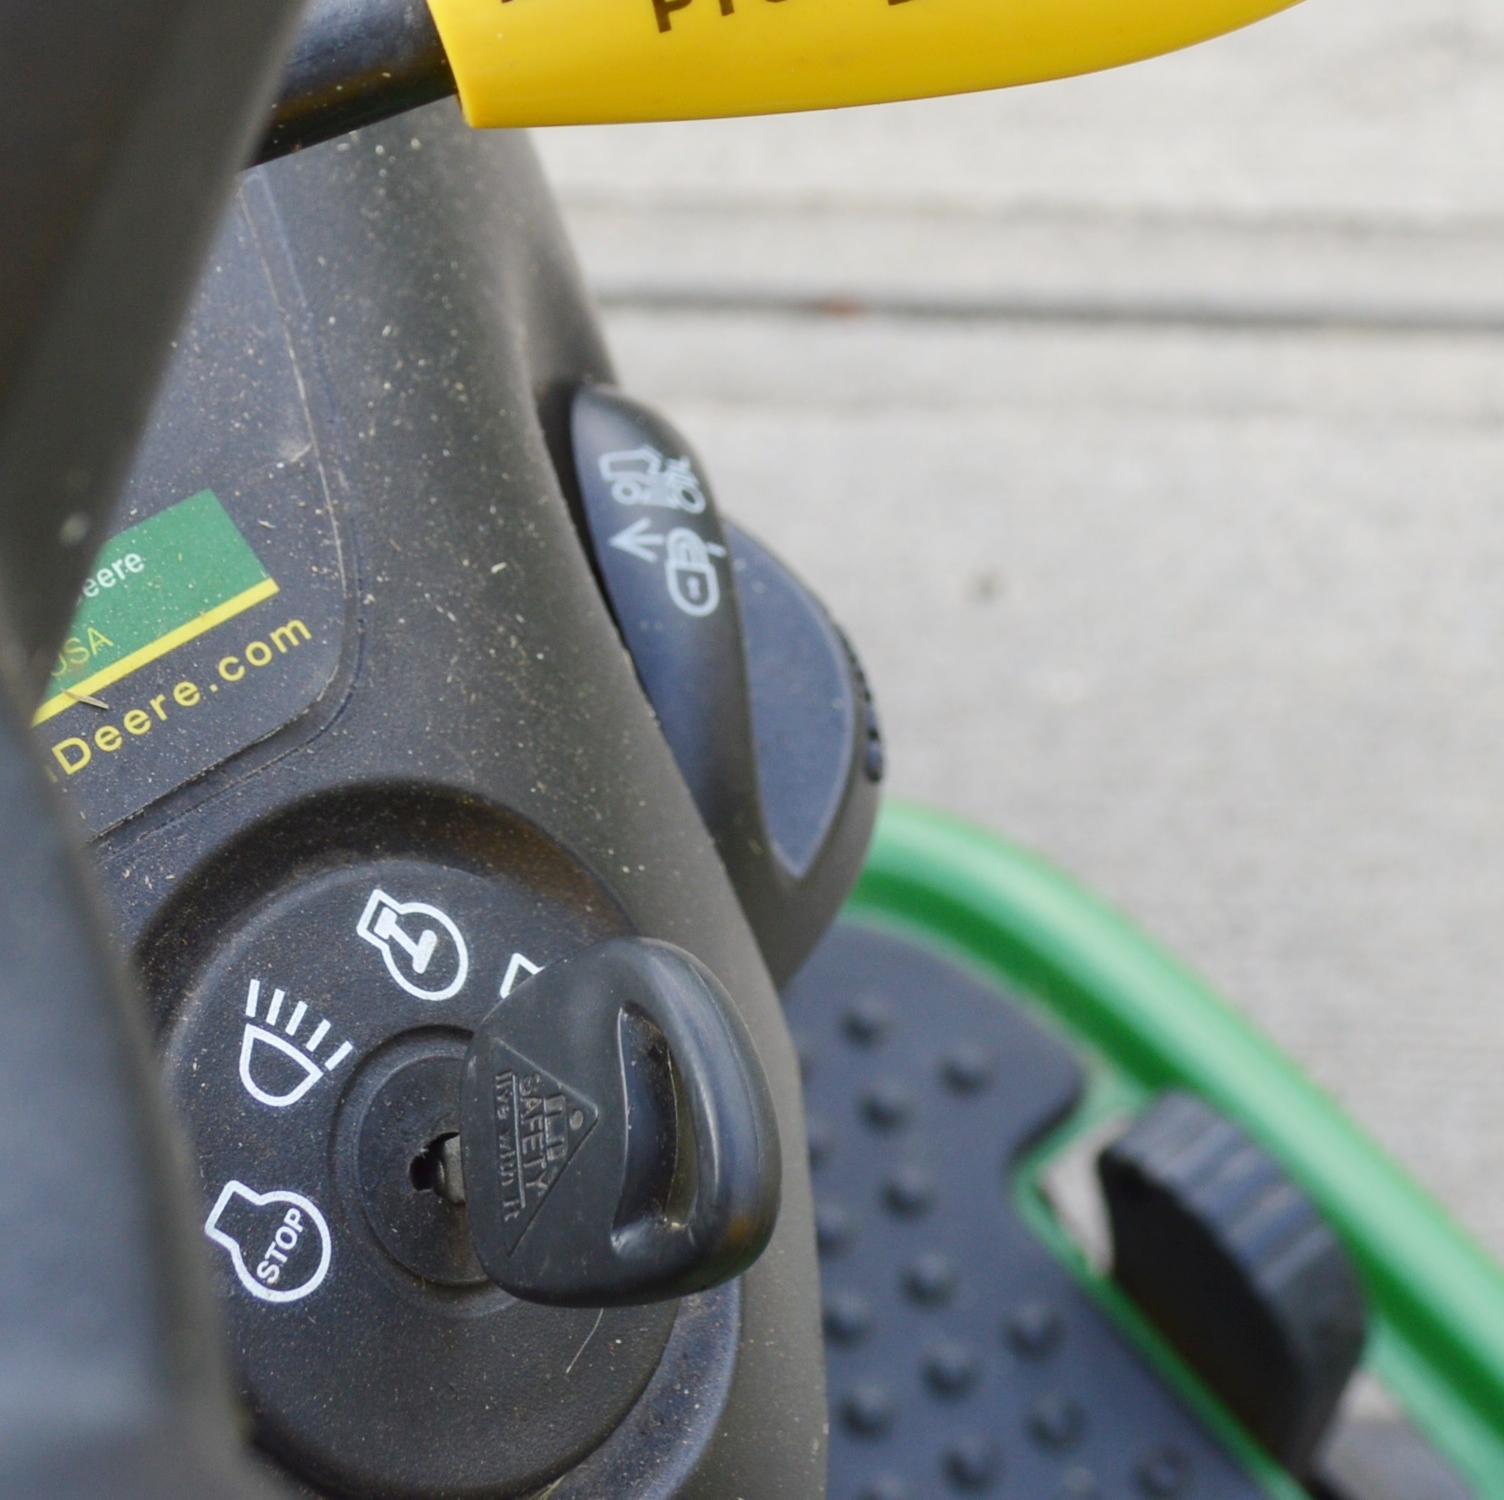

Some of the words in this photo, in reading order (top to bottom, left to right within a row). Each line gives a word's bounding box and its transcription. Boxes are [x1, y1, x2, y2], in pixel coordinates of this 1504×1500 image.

[79, 553, 144, 602] eere
[47, 619, 313, 784] Deere.com
[518, 1071, 549, 1197] SAFETY
[256, 1207, 304, 1284] STOP
